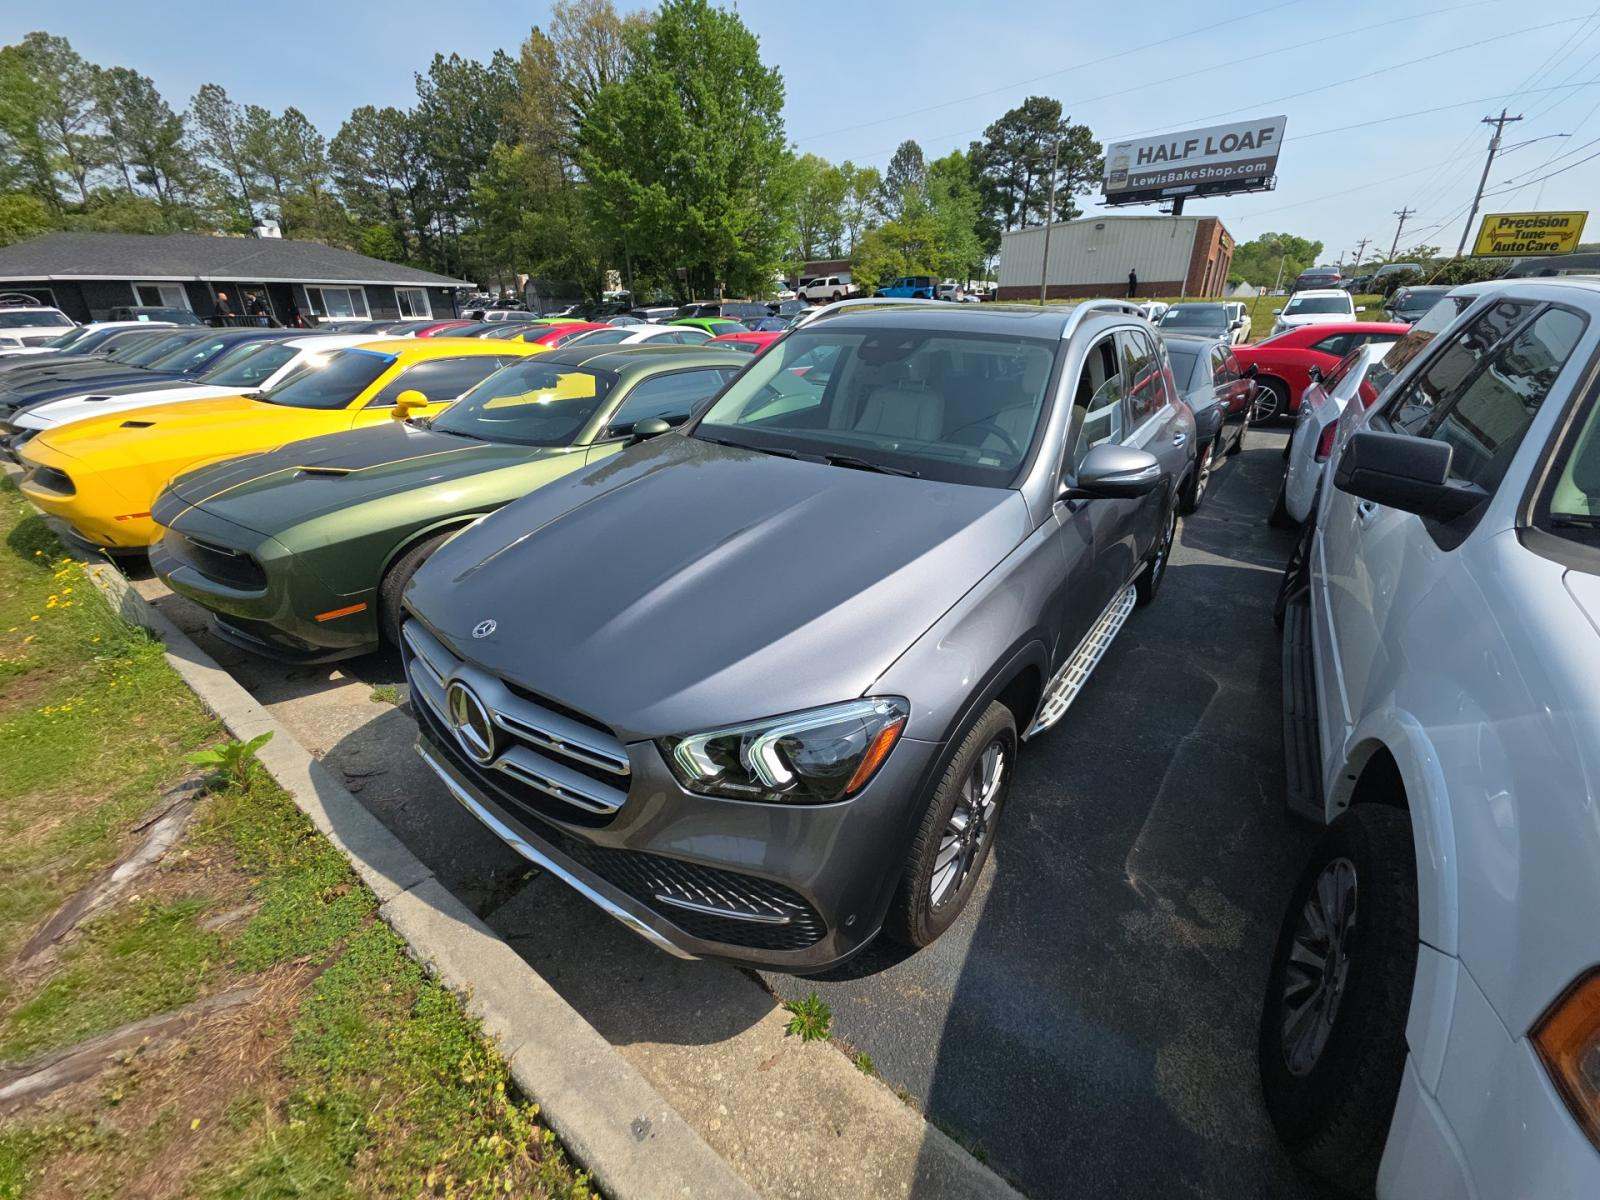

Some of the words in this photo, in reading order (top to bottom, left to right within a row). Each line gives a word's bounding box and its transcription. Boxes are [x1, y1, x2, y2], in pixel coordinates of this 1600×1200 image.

[1136, 138, 1199, 165] HALF
[1204, 127, 1275, 155] LOAF
[1132, 161, 1267, 187] LewisBakeShop.com
[1498, 216, 1569, 228] Precision
[1514, 230, 1545, 239] Tune
